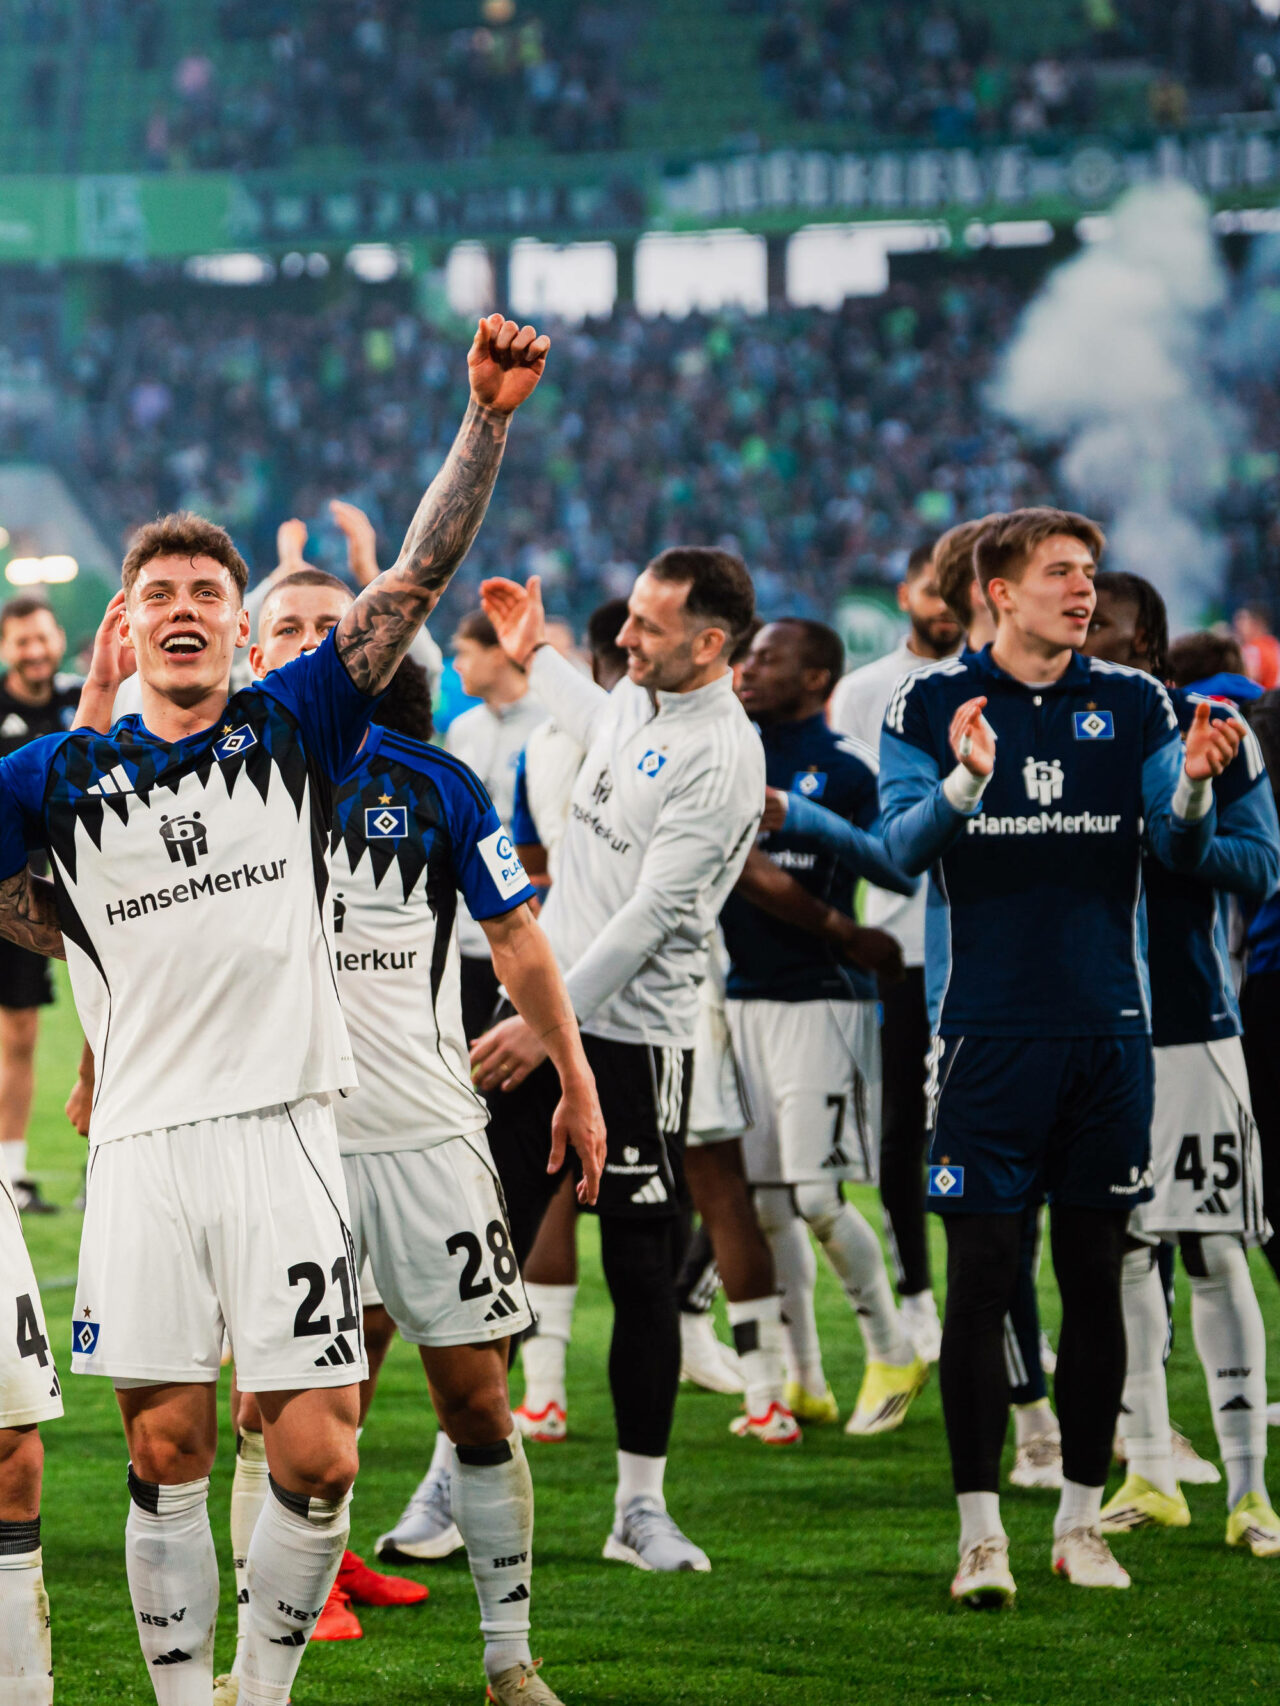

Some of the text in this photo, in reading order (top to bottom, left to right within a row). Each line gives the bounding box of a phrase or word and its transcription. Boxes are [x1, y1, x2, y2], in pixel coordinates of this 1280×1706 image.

[967, 811, 1121, 835] HanseMerkur
[106, 858, 287, 926] HanseMerkur
[827, 1093, 847, 1146] 7
[1174, 1134, 1240, 1191] 45
[446, 1219, 518, 1302] 28
[288, 1256, 357, 1338] 21
[15, 1293, 49, 1368] 4
[493, 1551, 528, 1568] HSV
[139, 1606, 186, 1627] HSV
